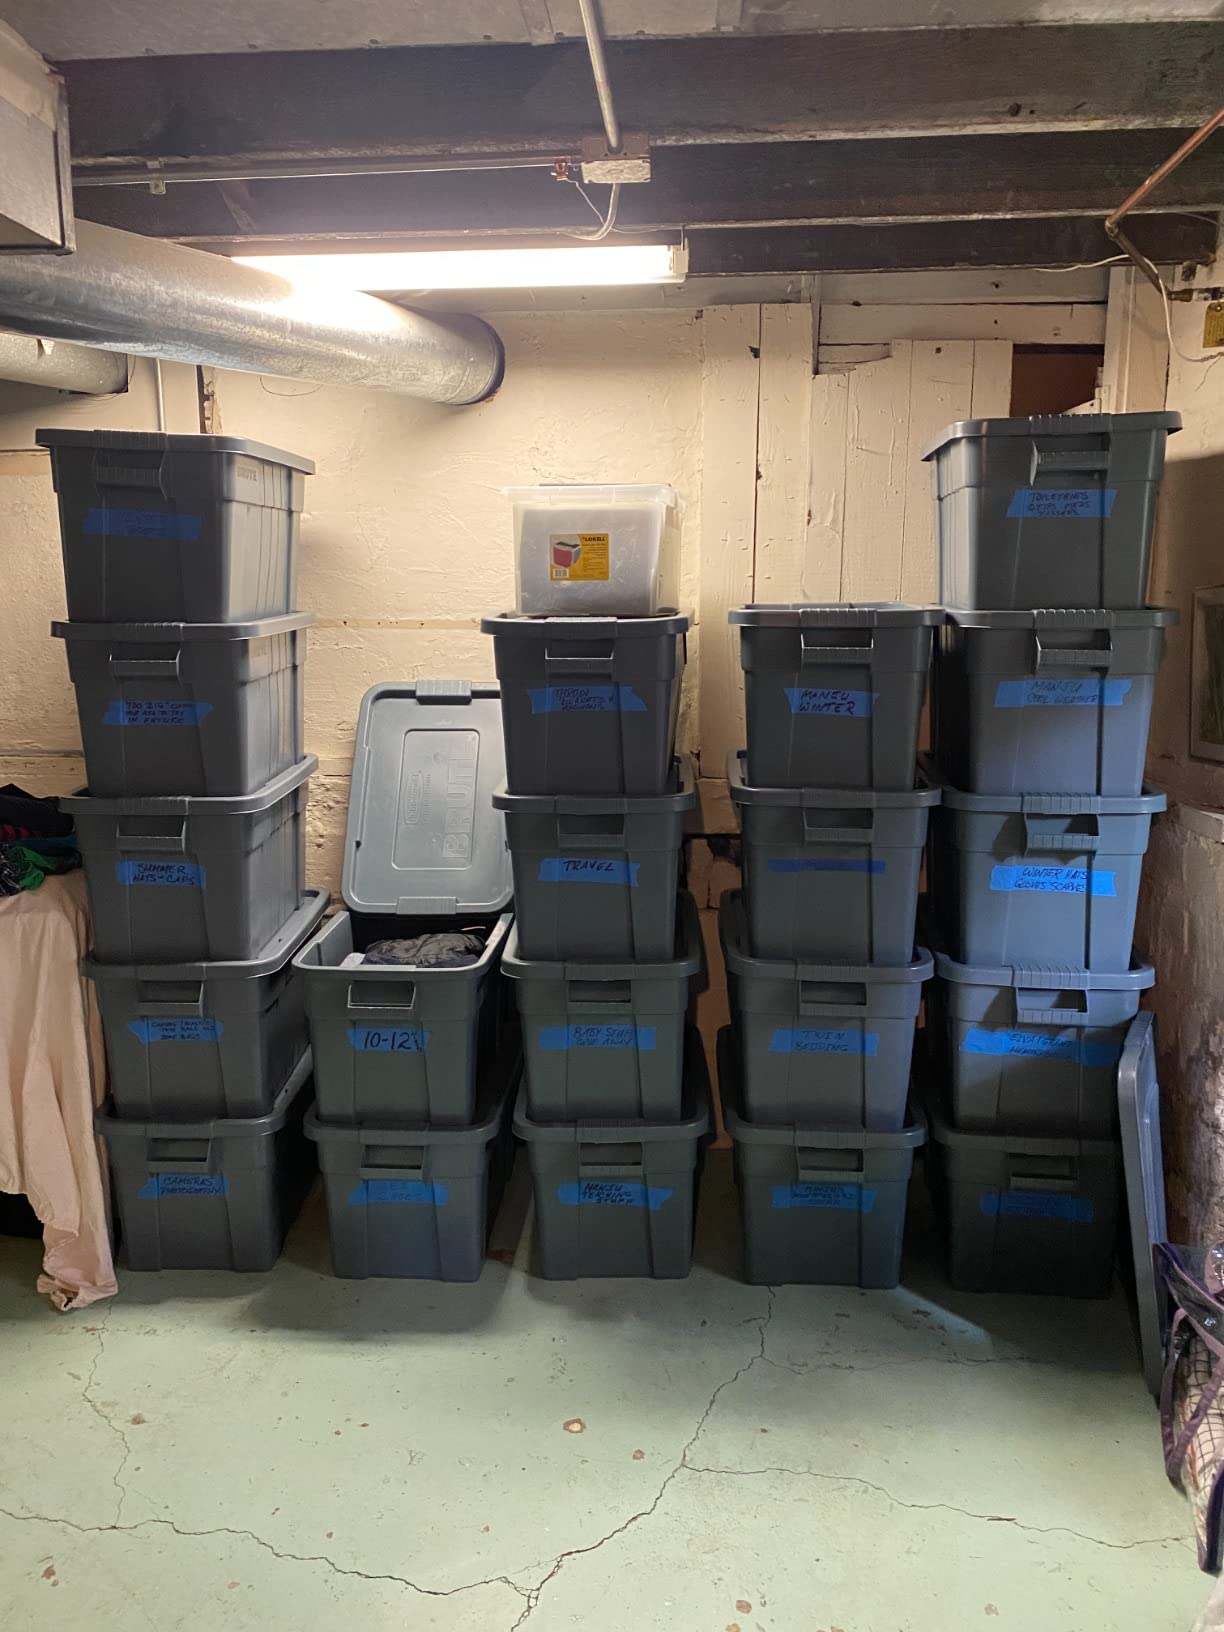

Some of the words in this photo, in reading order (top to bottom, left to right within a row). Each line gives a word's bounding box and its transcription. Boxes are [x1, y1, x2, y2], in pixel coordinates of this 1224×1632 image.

[799, 700, 856, 715] WINTER
[563, 860, 616, 872] TRAVEL
[1022, 867, 1064, 878] WINTER
[1014, 876, 1049, 890] GLOVES
[161, 1175, 214, 1187] CAMERAS
